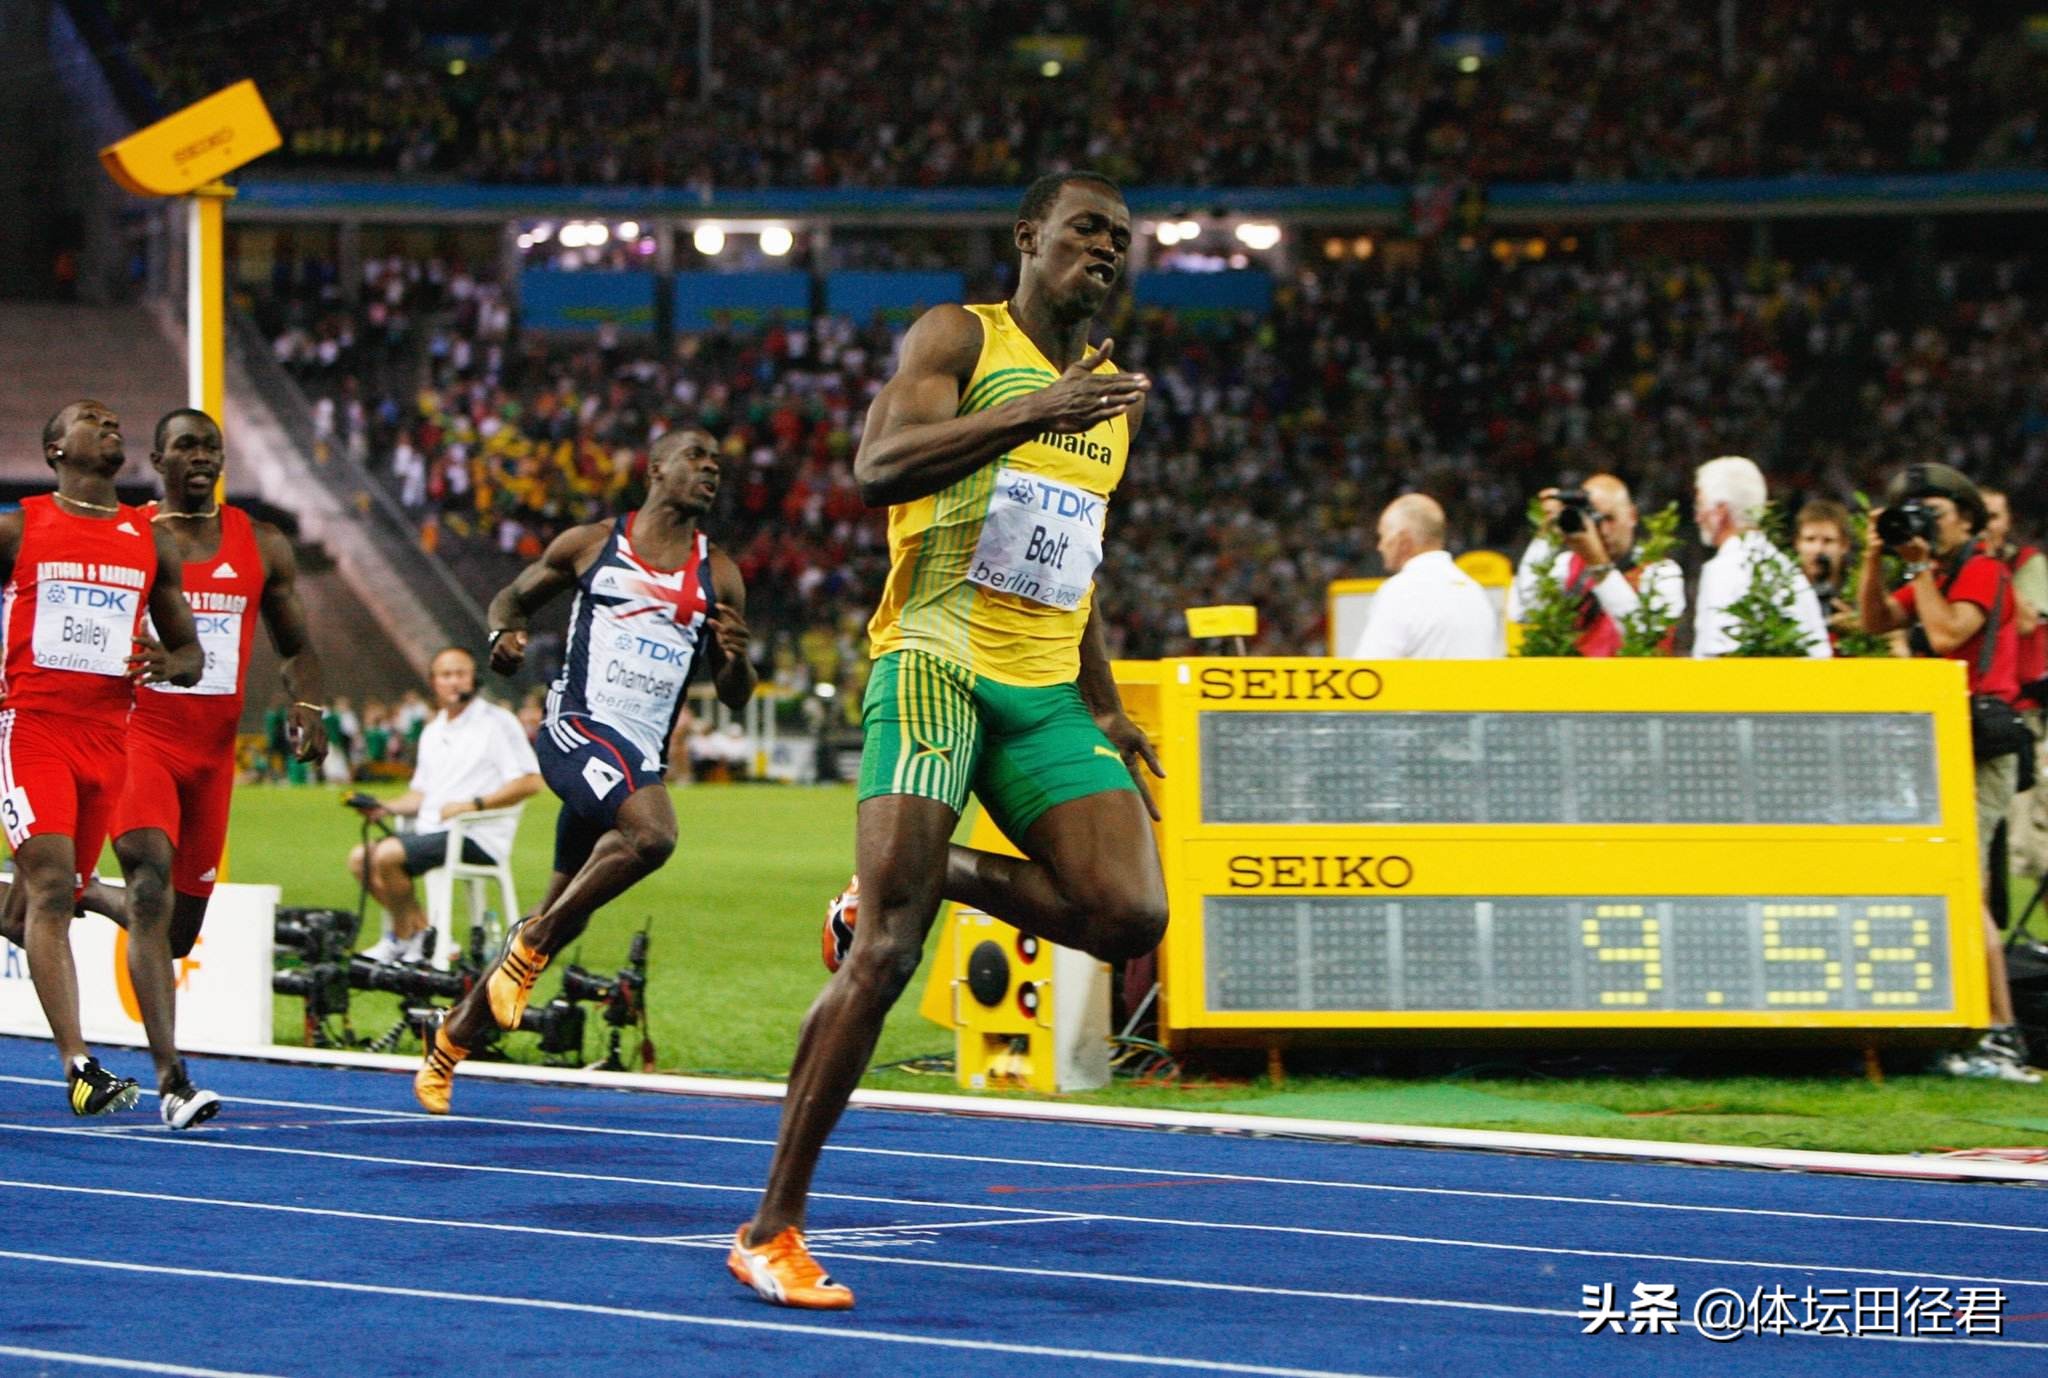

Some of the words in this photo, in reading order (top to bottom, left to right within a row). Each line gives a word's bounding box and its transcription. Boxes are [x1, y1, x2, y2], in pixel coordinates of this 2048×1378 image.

[1033, 432, 1113, 466] maica
[1036, 482, 1098, 527] TDK
[1024, 524, 1070, 570] Bolt
[972, 561, 1041, 597] berlin
[67, 586, 128, 612] TDK
[62, 615, 110, 653] Bailey
[36, 650, 90, 669] berlin
[635, 636, 688, 667] TDK
[606, 659, 675, 700] Chambers
[1199, 668, 1383, 700] SEIKO
[2, 798, 20, 831] 3
[1228, 855, 1414, 888] SEIKO
[1582, 904, 1934, 1005] 9.58
